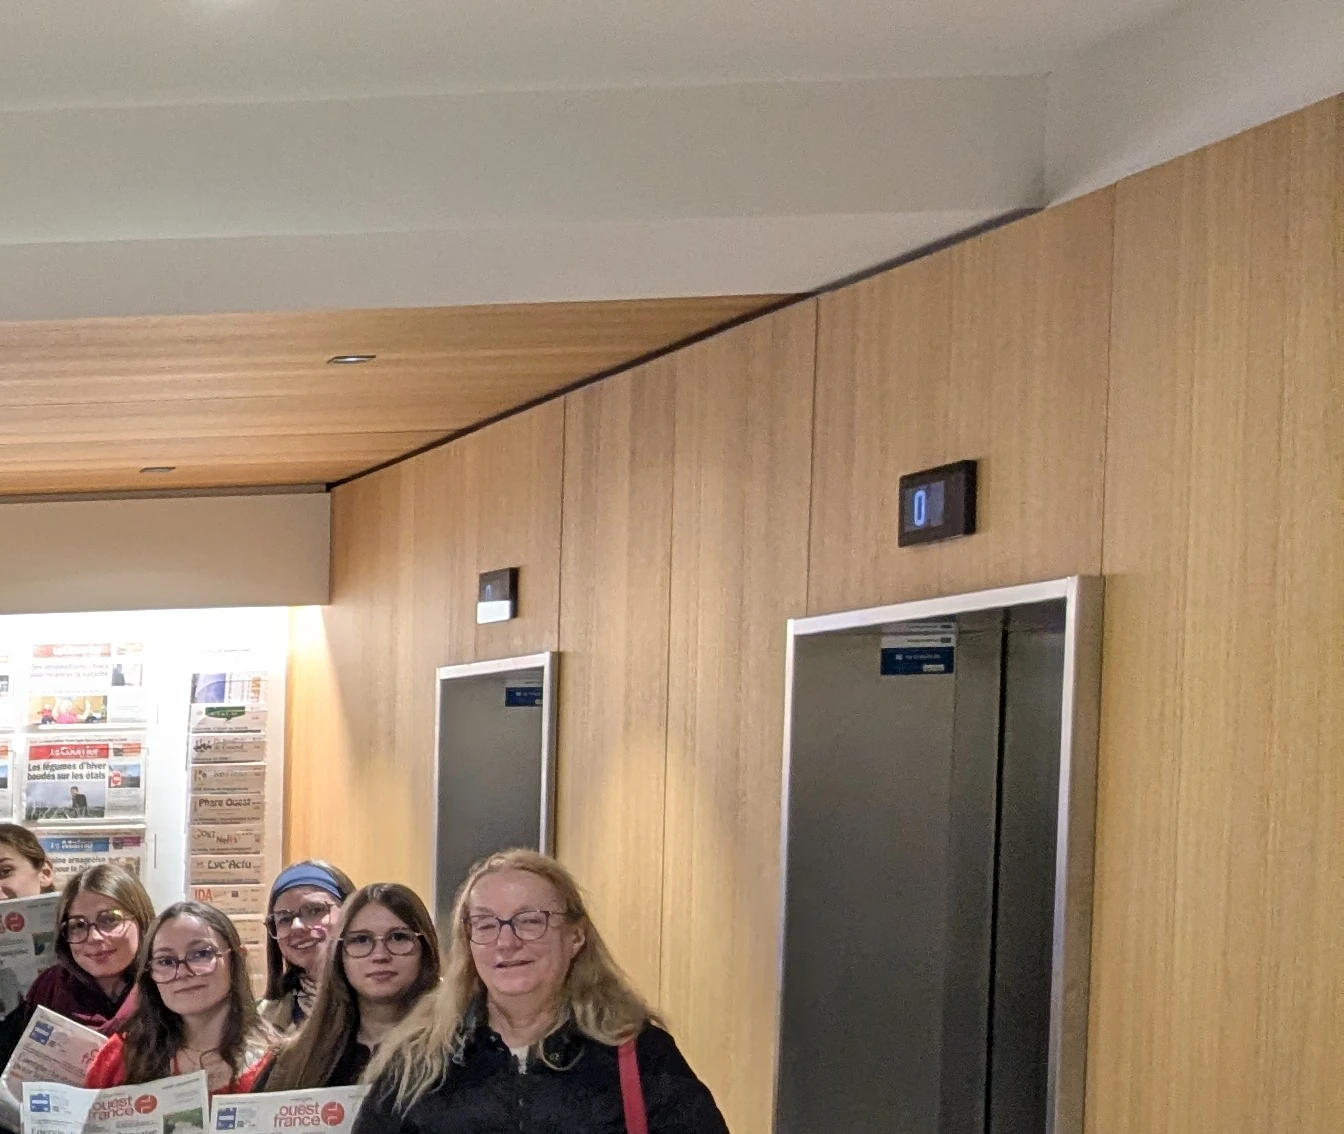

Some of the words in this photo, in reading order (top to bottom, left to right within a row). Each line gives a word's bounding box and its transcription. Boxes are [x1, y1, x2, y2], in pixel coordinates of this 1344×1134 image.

[914, 490, 925, 526] 0
[279, 1102, 320, 1116] ouest
[273, 1114, 320, 1128] france
